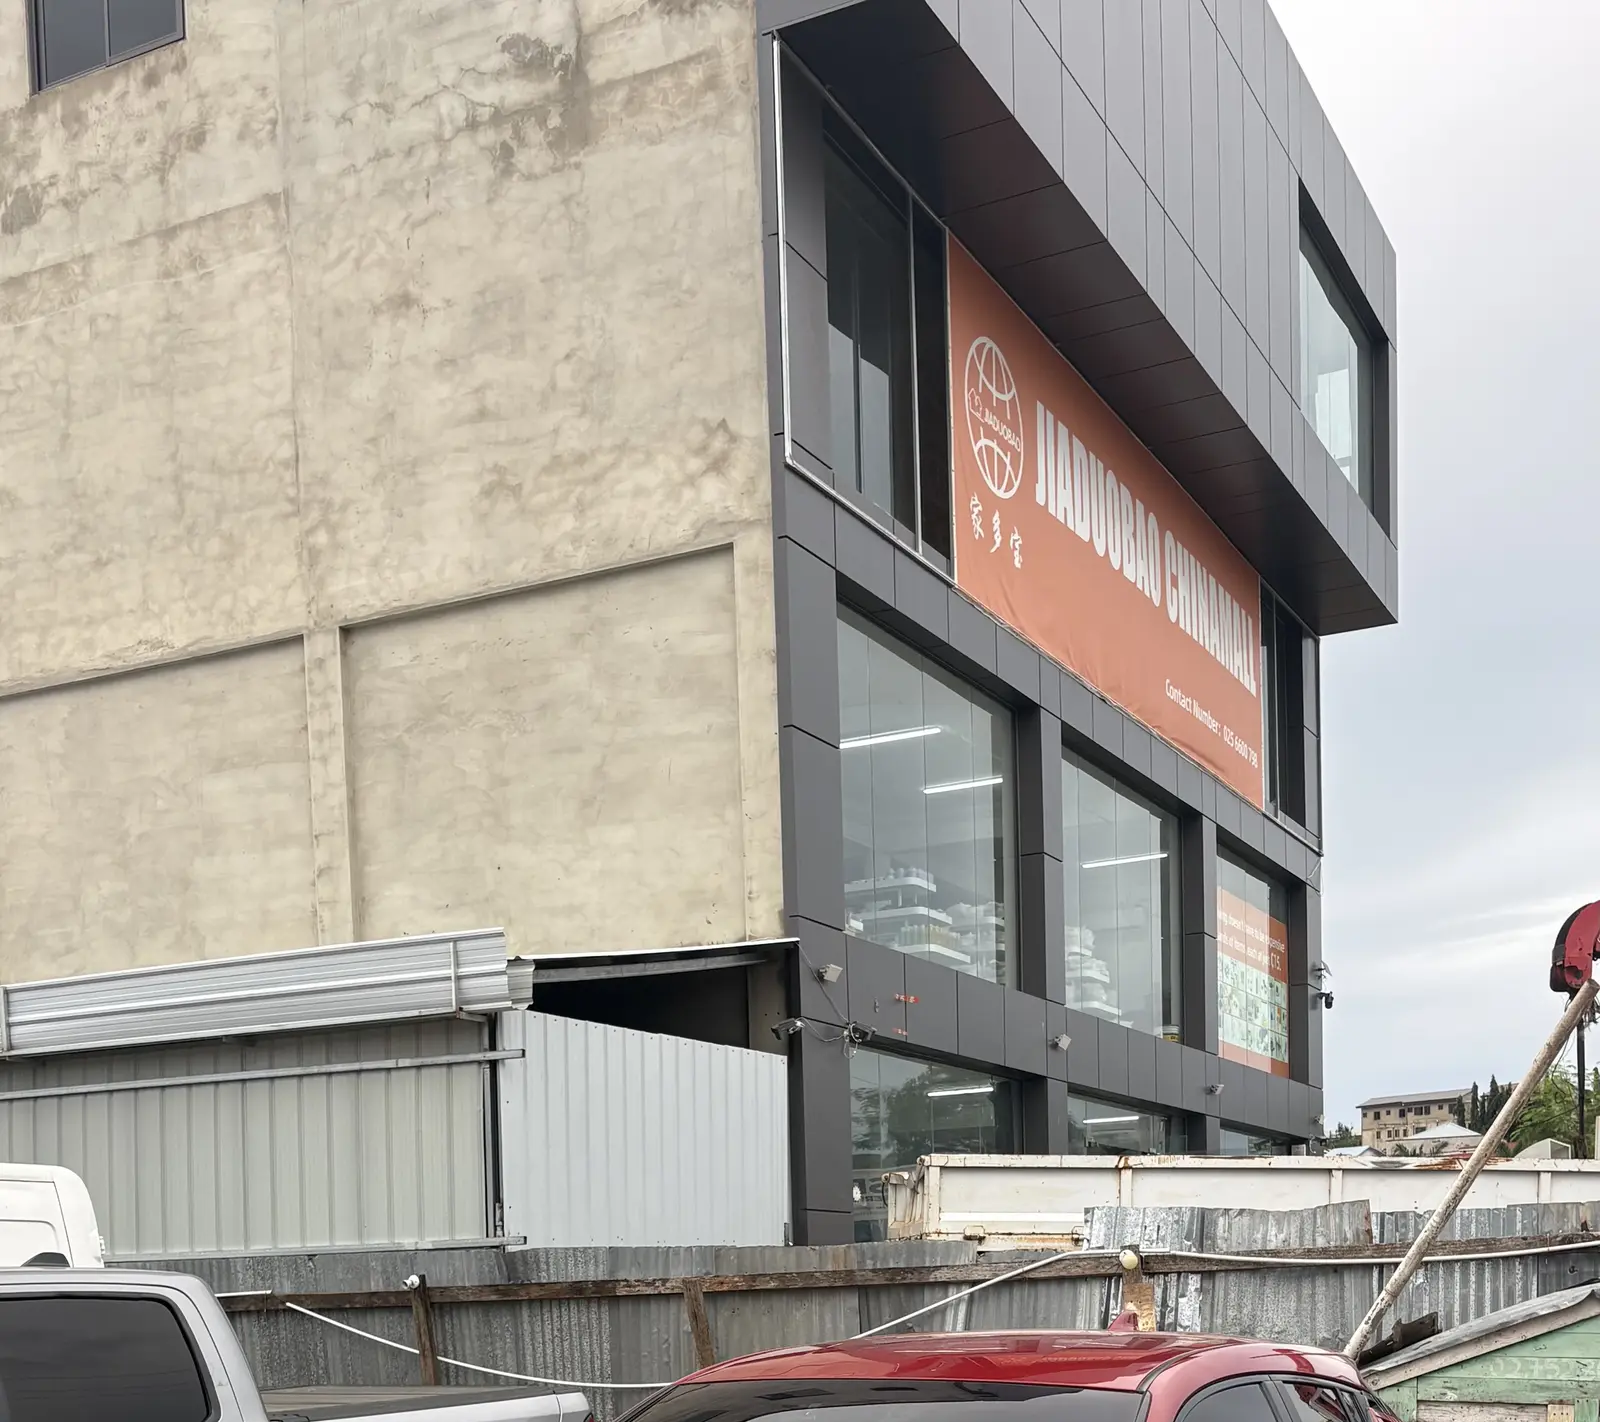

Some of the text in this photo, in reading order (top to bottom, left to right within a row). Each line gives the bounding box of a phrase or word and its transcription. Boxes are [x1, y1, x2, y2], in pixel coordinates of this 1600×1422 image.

[984, 407, 1020, 452] JIADUOBAO
[1036, 400, 1256, 697] JIADUOBAO CHINAMALL
[1165, 678, 1192, 713] Contact
[1193, 699, 1221, 736] Number:
[1223, 725, 1234, 747] 025
